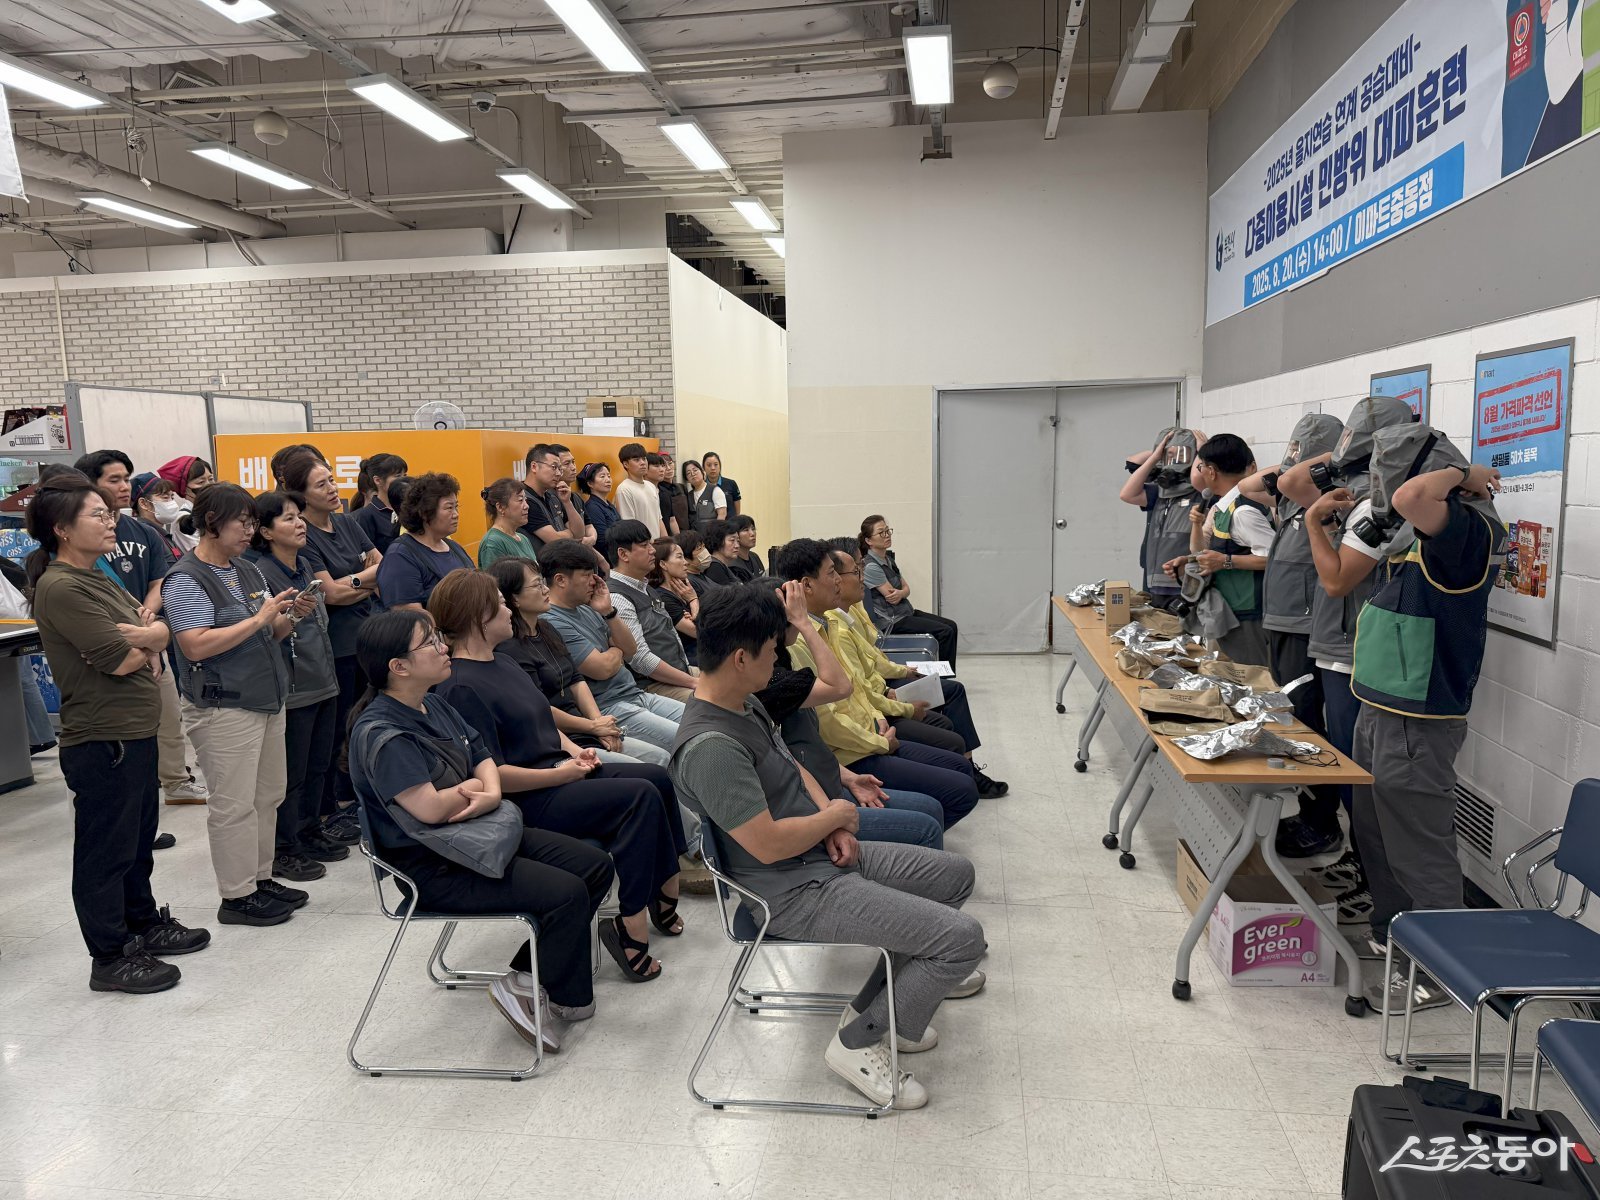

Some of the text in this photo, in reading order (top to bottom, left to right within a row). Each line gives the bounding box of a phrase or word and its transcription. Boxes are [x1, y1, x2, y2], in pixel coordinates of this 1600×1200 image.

[1295, 112, 1332, 169] 을지연습
[1335, 85, 1358, 135] 연계
[1360, 33, 1421, 113] 공습대비-
[1244, 44, 1468, 258] 다중이용시설 민방위 대피훈련
[1313, 223, 1343, 266] 14:00
[1344, 215, 1352, 251] /
[1354, 168, 1434, 245] 이마트중동점
[1483, 403, 1498, 424] 8월
[1501, 393, 1533, 420] 가격파격
[1534, 388, 1553, 412] 선언
[1491, 451, 1510, 468] 생필품
[1523, 446, 1538, 463] 품목
[1243, 924, 1286, 945] Ever
[1243, 936, 1301, 965] green
[1300, 972, 1315, 983] A4
